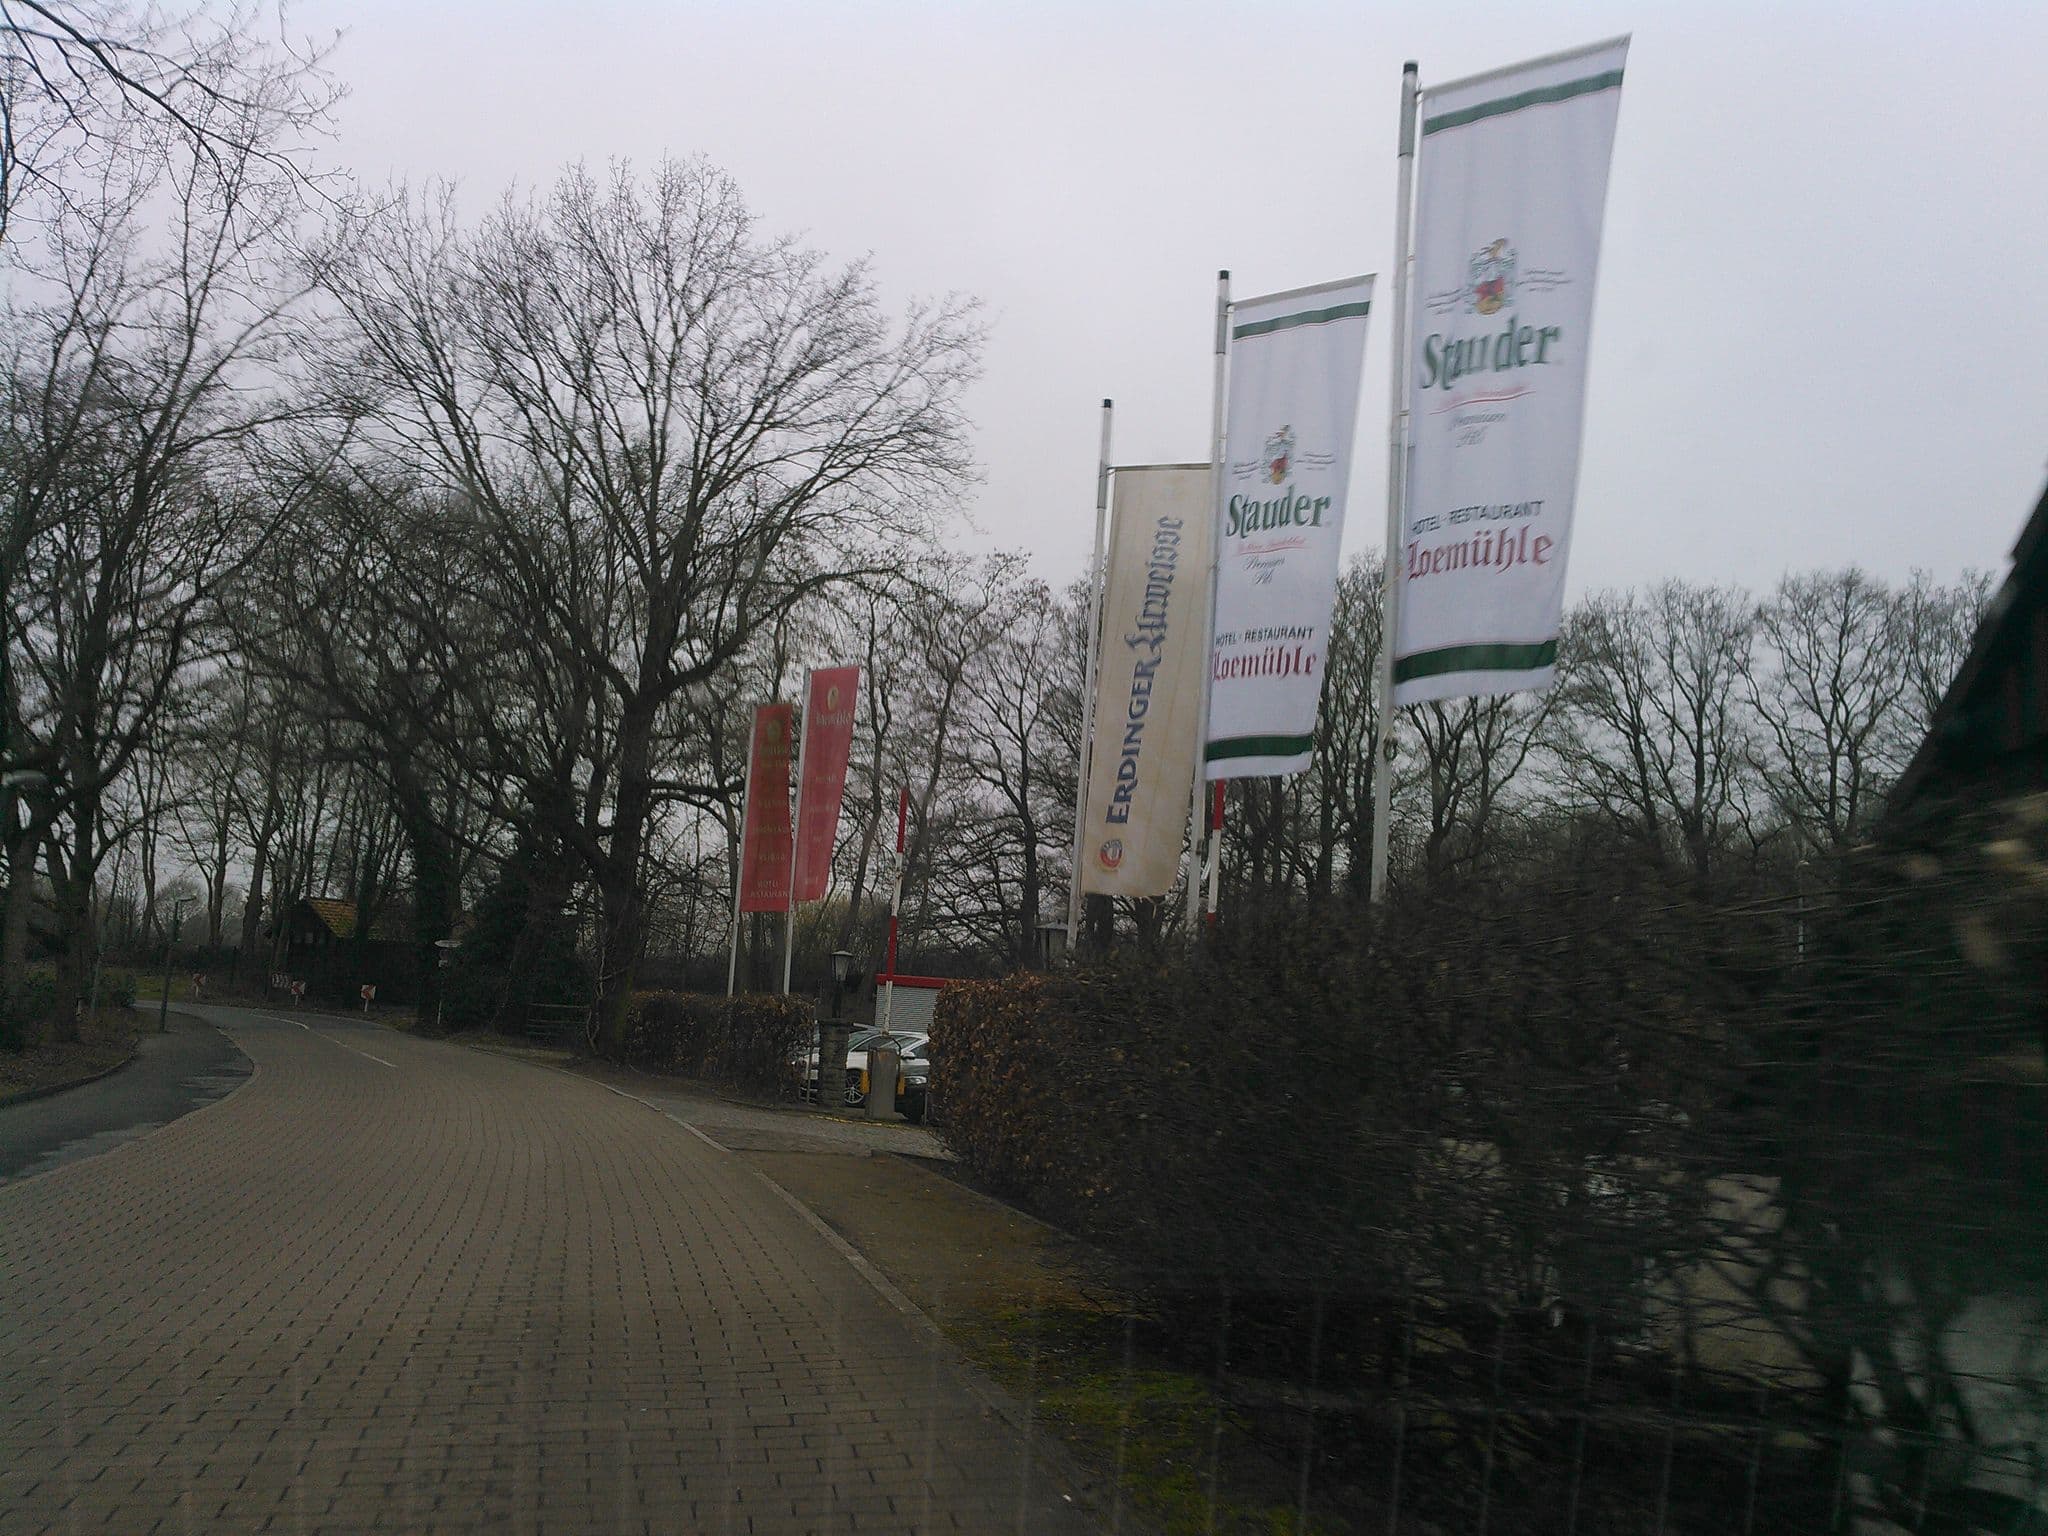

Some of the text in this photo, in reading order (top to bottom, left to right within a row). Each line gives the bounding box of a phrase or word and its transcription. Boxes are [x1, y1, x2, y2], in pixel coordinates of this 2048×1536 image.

[1419, 314, 1562, 390] Stauder
[1226, 483, 1331, 538] Stauder
[1408, 523, 1553, 581] Loemühle
[1106, 656, 1162, 824] ERDINGER
